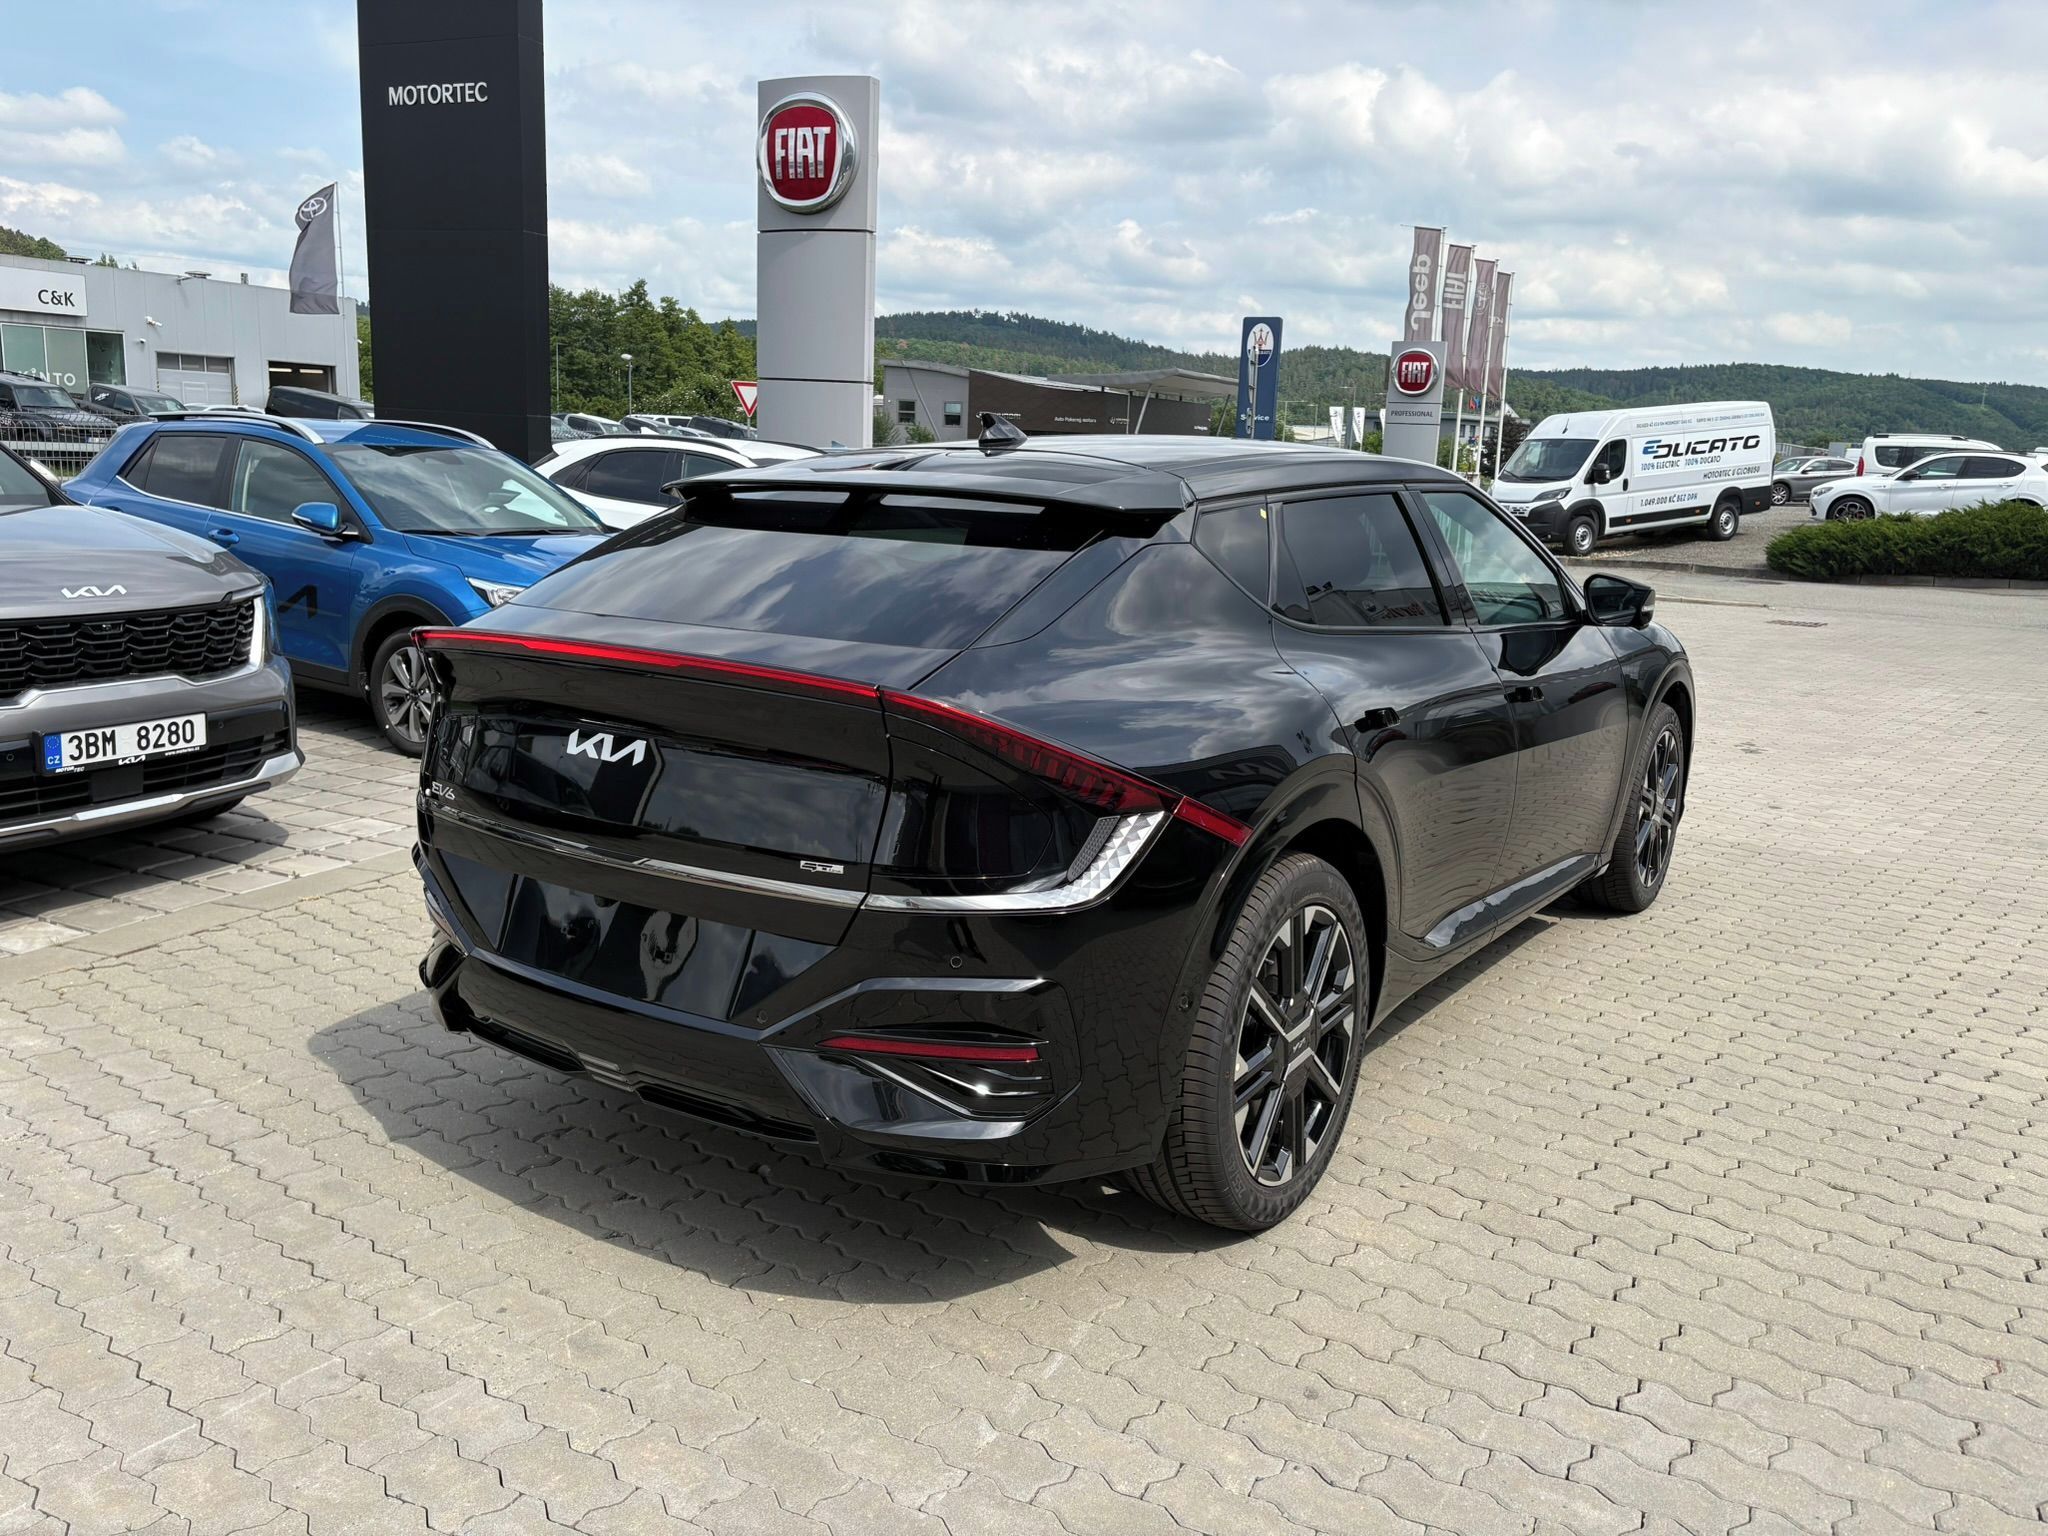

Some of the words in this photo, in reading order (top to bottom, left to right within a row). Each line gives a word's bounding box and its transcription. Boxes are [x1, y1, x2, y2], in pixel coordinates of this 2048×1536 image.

[388, 82, 488, 106] MOTORTEC
[775, 126, 832, 180] FIAT
[37, 289, 75, 307] C&K
[18, 367, 76, 386] NTO
[1401, 361, 1430, 384] FIAT
[1240, 413, 1271, 422] Svice
[1390, 410, 1434, 418] PROFESSIONAL
[1641, 462, 1655, 471] 100%
[1655, 459, 1681, 470] ELECTRIC
[1684, 457, 1699, 466] 100%
[1640, 495, 1668, 507] 1.049.000
[61, 584, 127, 599] KIA
[68, 729, 116, 761] 3BM
[137, 719, 195, 751] 8280
[566, 728, 647, 766] KIA
[47, 755, 61, 765] CZ
[118, 754, 146, 766] KIA
[431, 781, 456, 800] EV6
